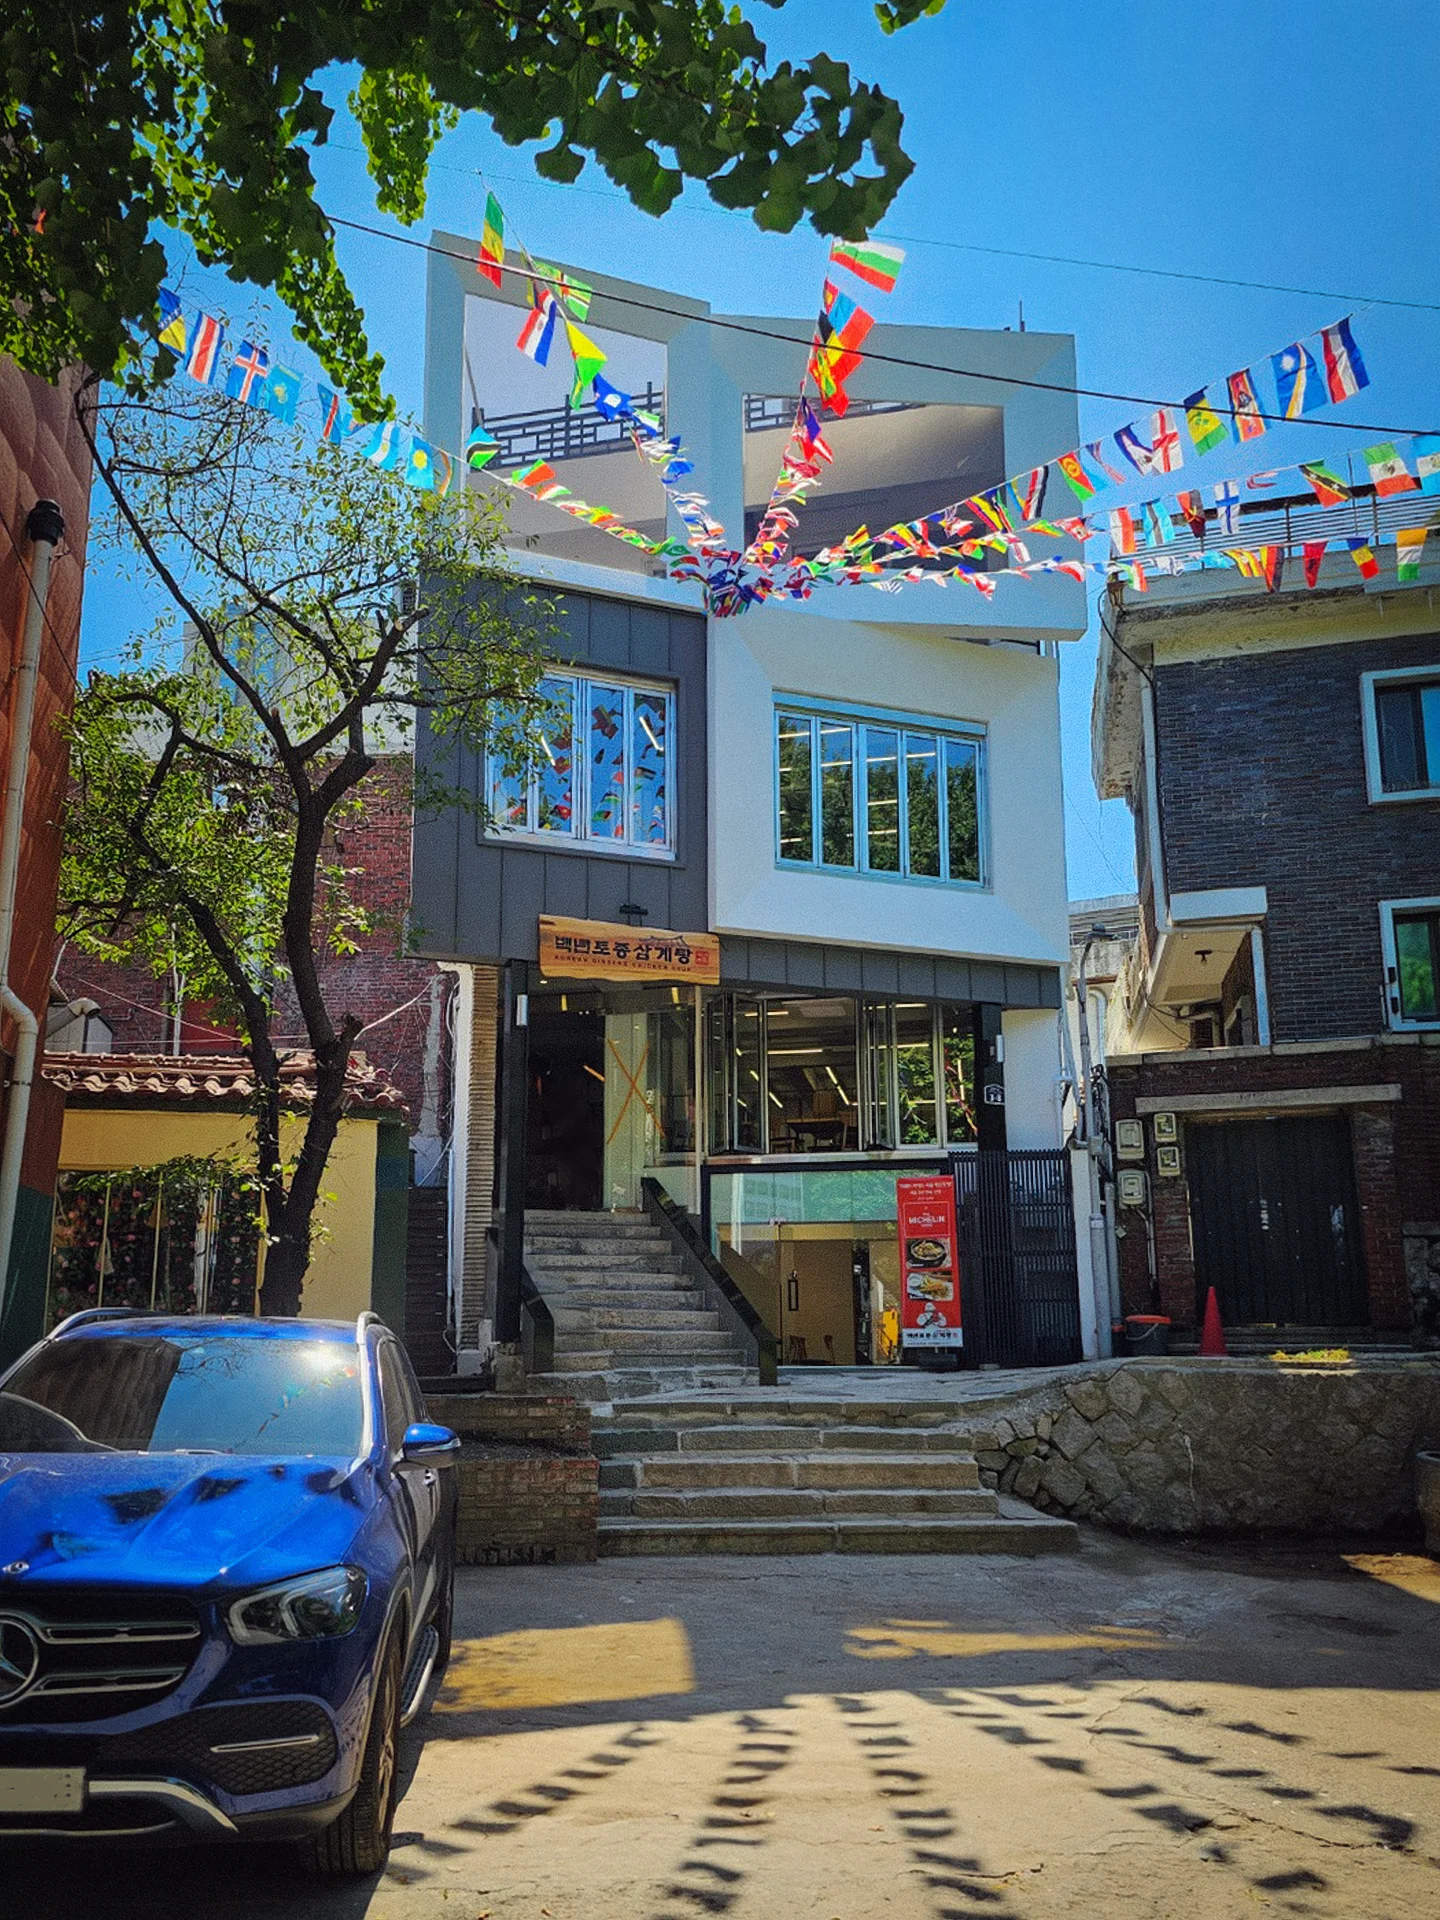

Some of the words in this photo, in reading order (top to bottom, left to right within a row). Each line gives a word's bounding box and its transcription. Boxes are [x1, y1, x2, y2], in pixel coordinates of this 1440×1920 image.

[555, 935, 693, 965] 백년토종삼계탕
[554, 955, 588, 963] KOREAN
[592, 958, 629, 967] GINSENG
[632, 962, 668, 970] CHICKEN
[908, 1215, 945, 1224] MICHELIN
